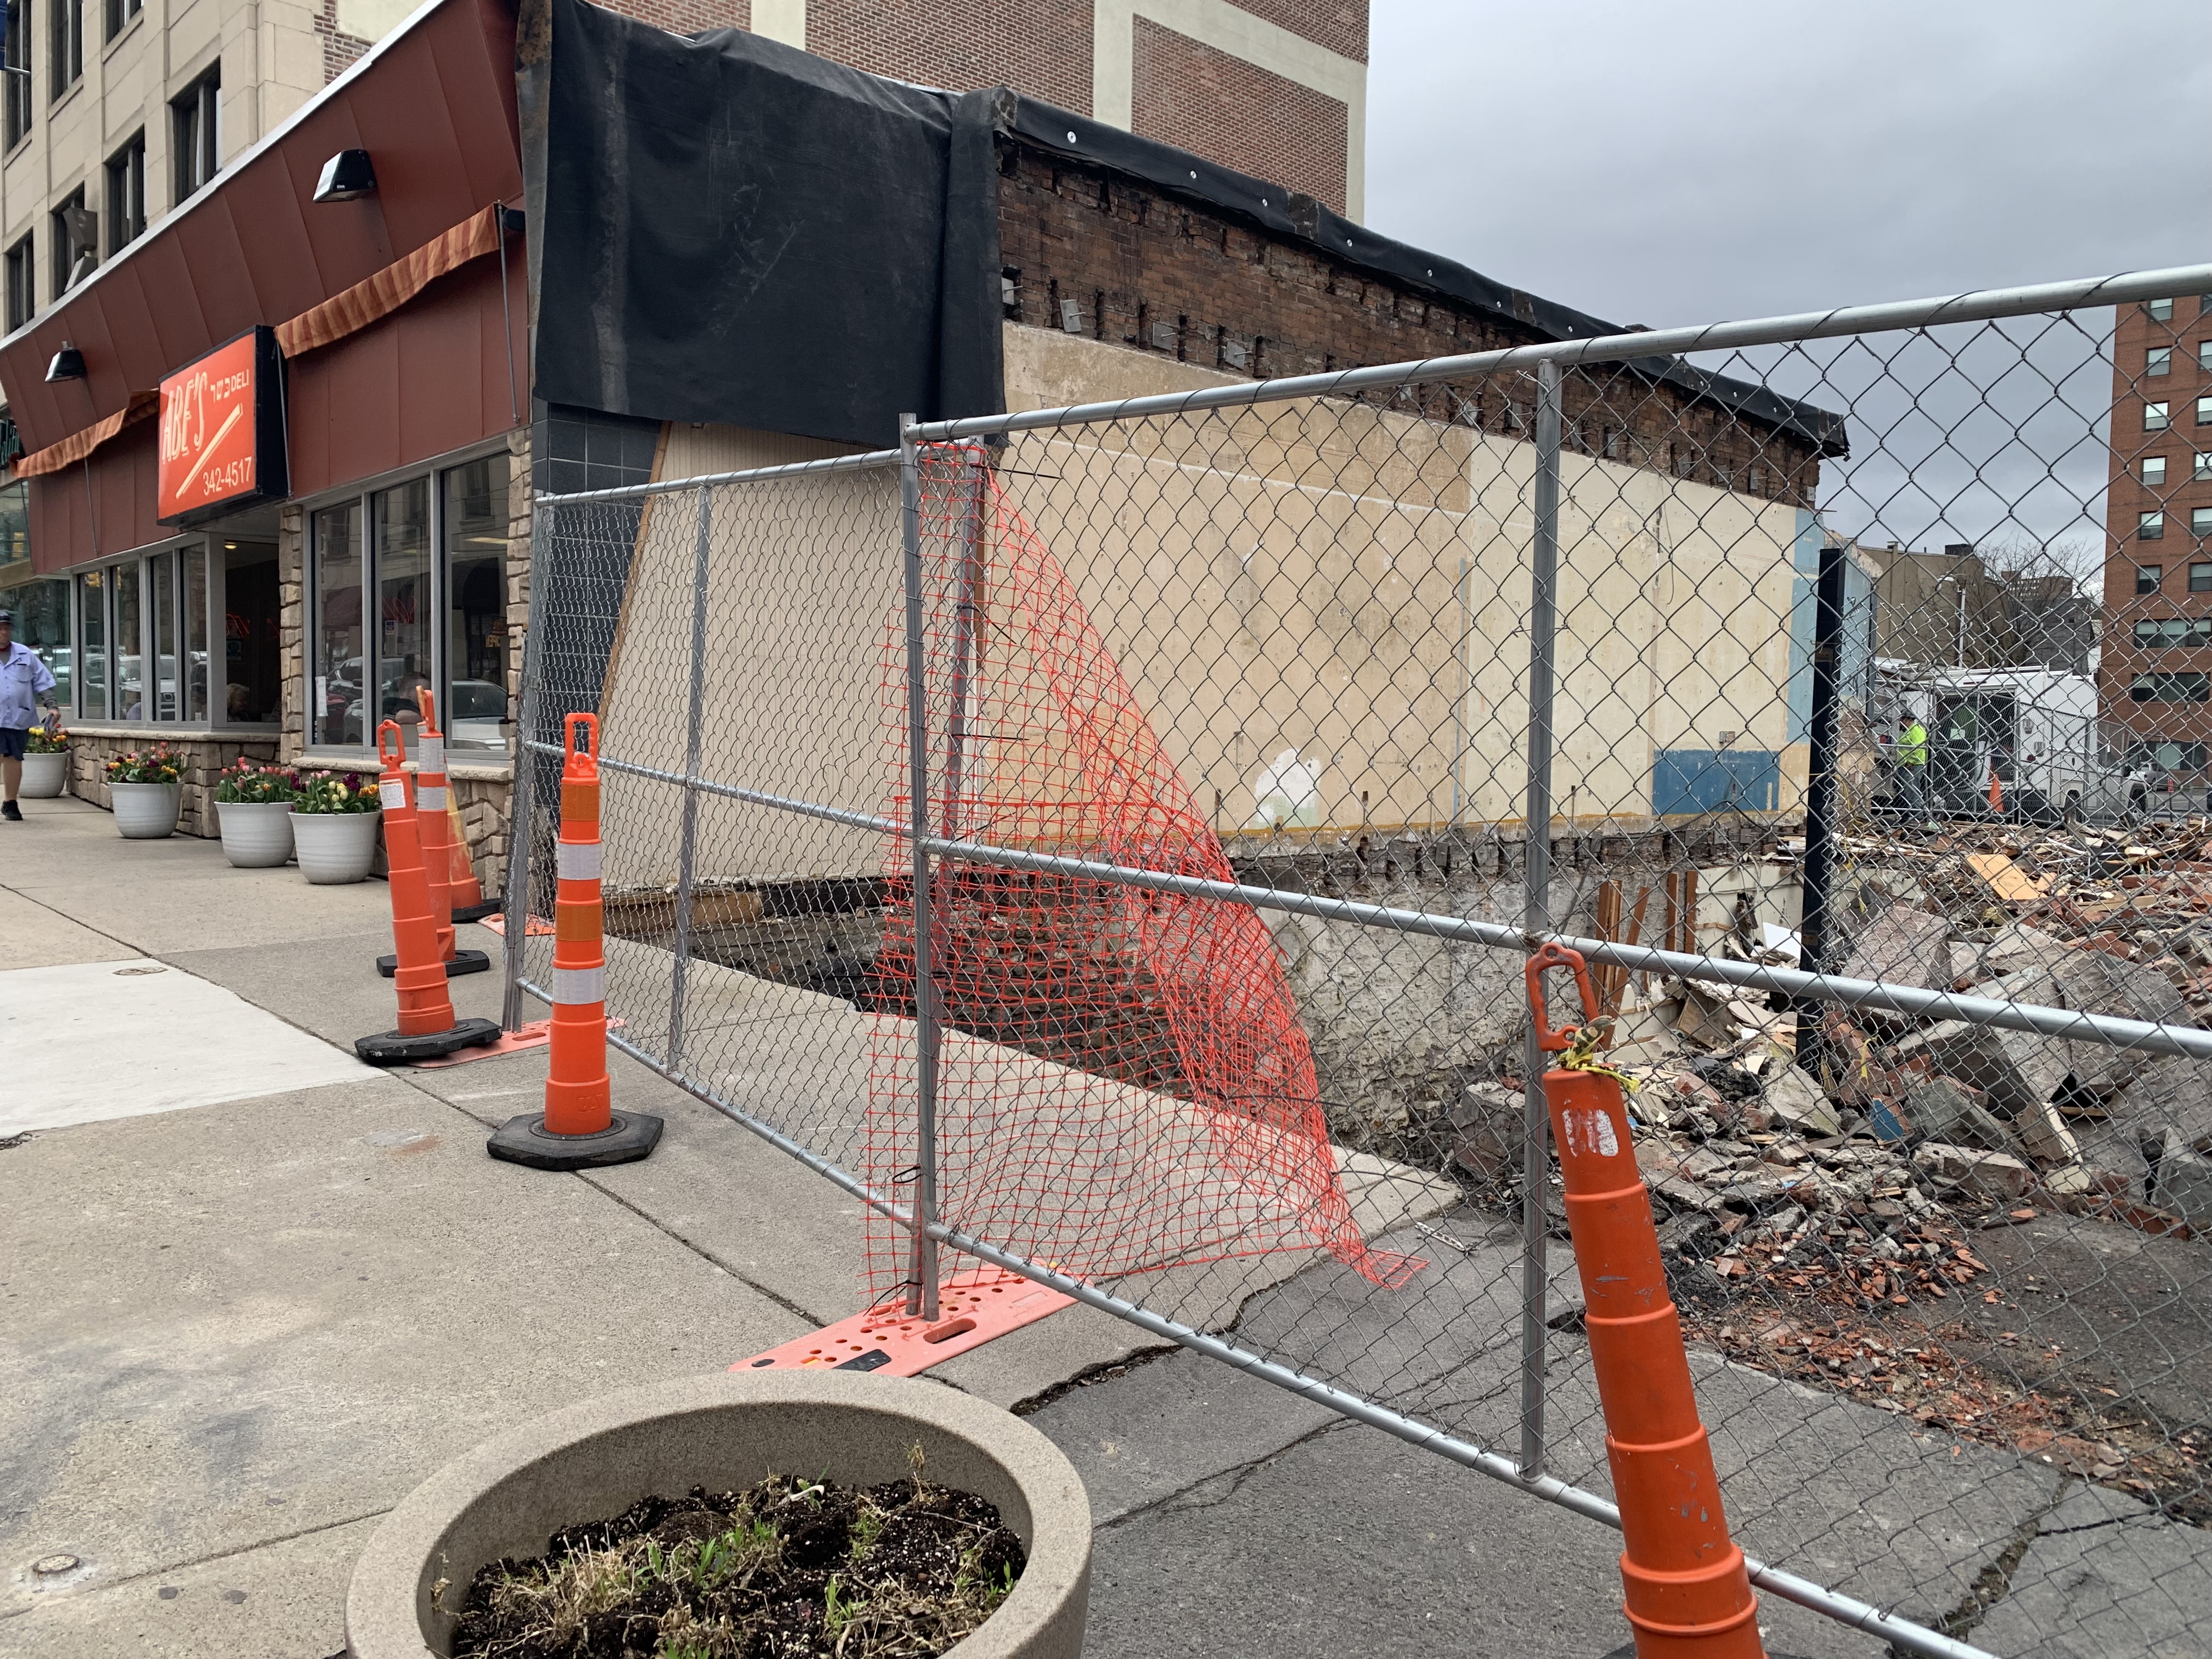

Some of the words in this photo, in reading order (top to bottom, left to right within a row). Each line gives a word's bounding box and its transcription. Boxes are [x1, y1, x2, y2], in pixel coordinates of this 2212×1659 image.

[231, 369, 249, 392] DELI
[162, 371, 207, 464] ABE'S
[203, 456, 252, 496] 342-4517
